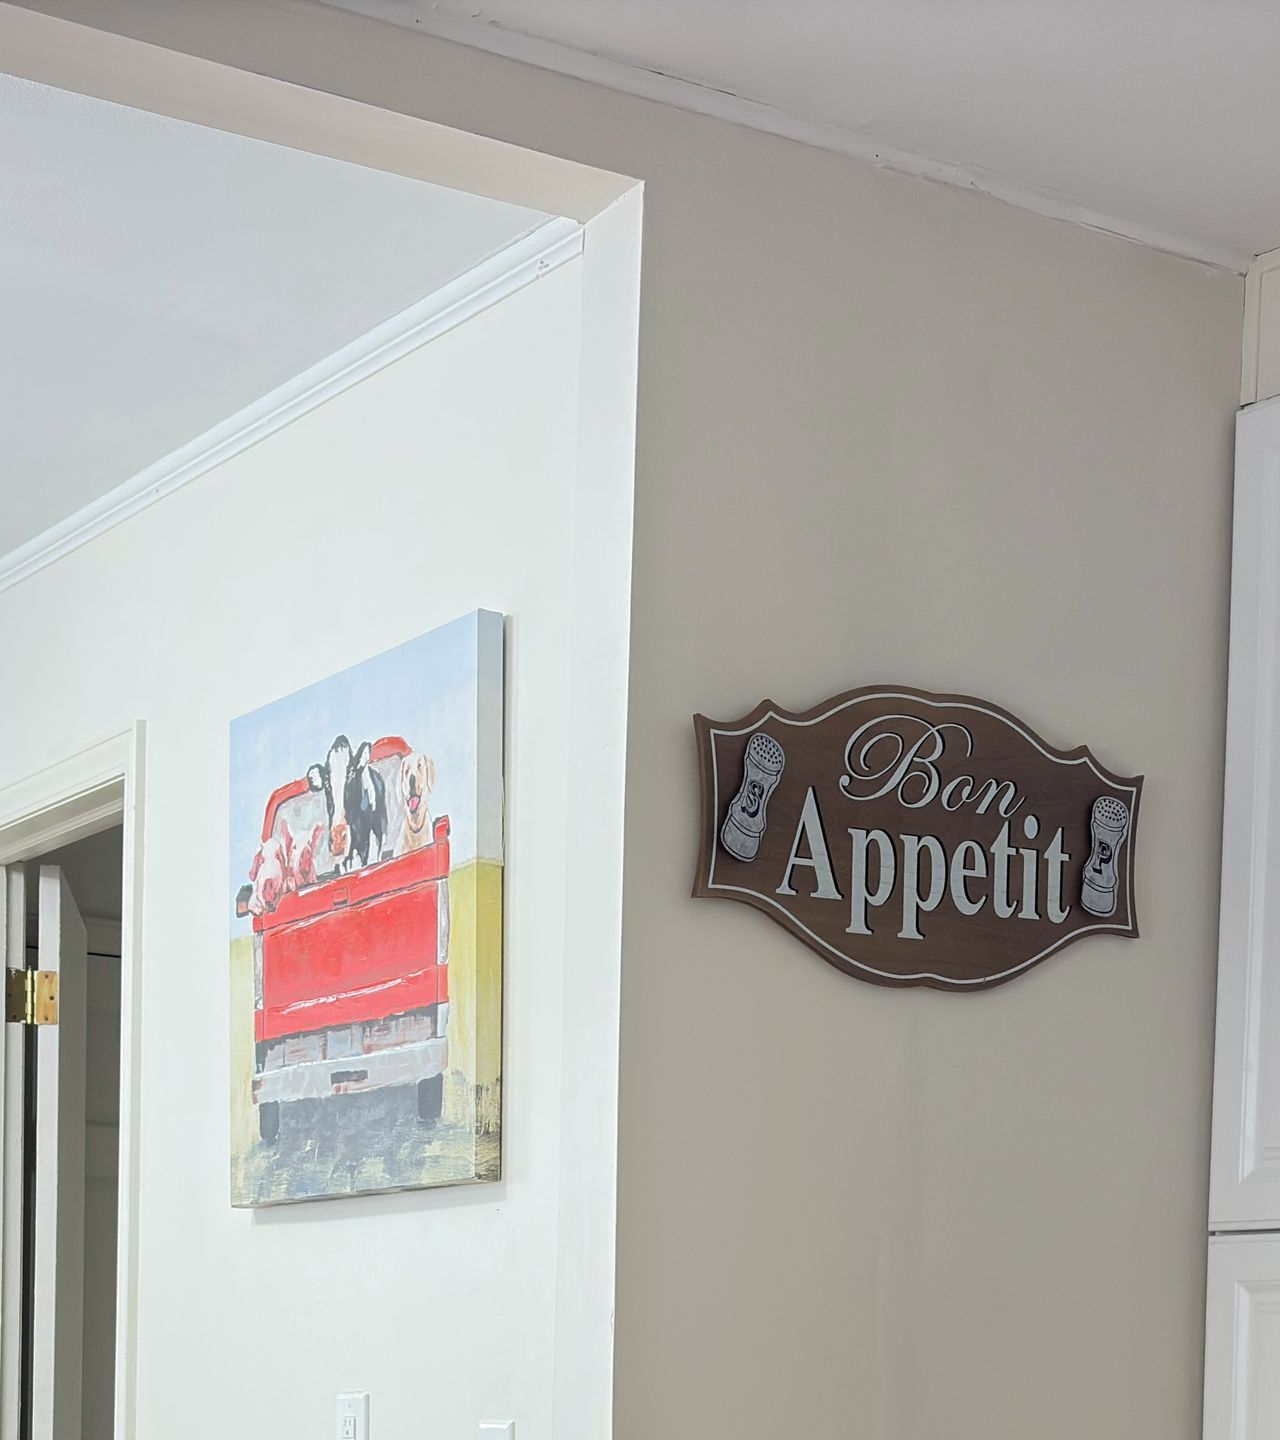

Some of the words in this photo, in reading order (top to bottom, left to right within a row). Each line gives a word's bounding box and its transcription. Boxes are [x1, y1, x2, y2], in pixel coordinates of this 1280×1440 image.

[741, 779, 765, 818] S
[838, 714, 1025, 818] Bon
[775, 786, 1072, 939] Appetit
[1091, 839, 1113, 875] P
